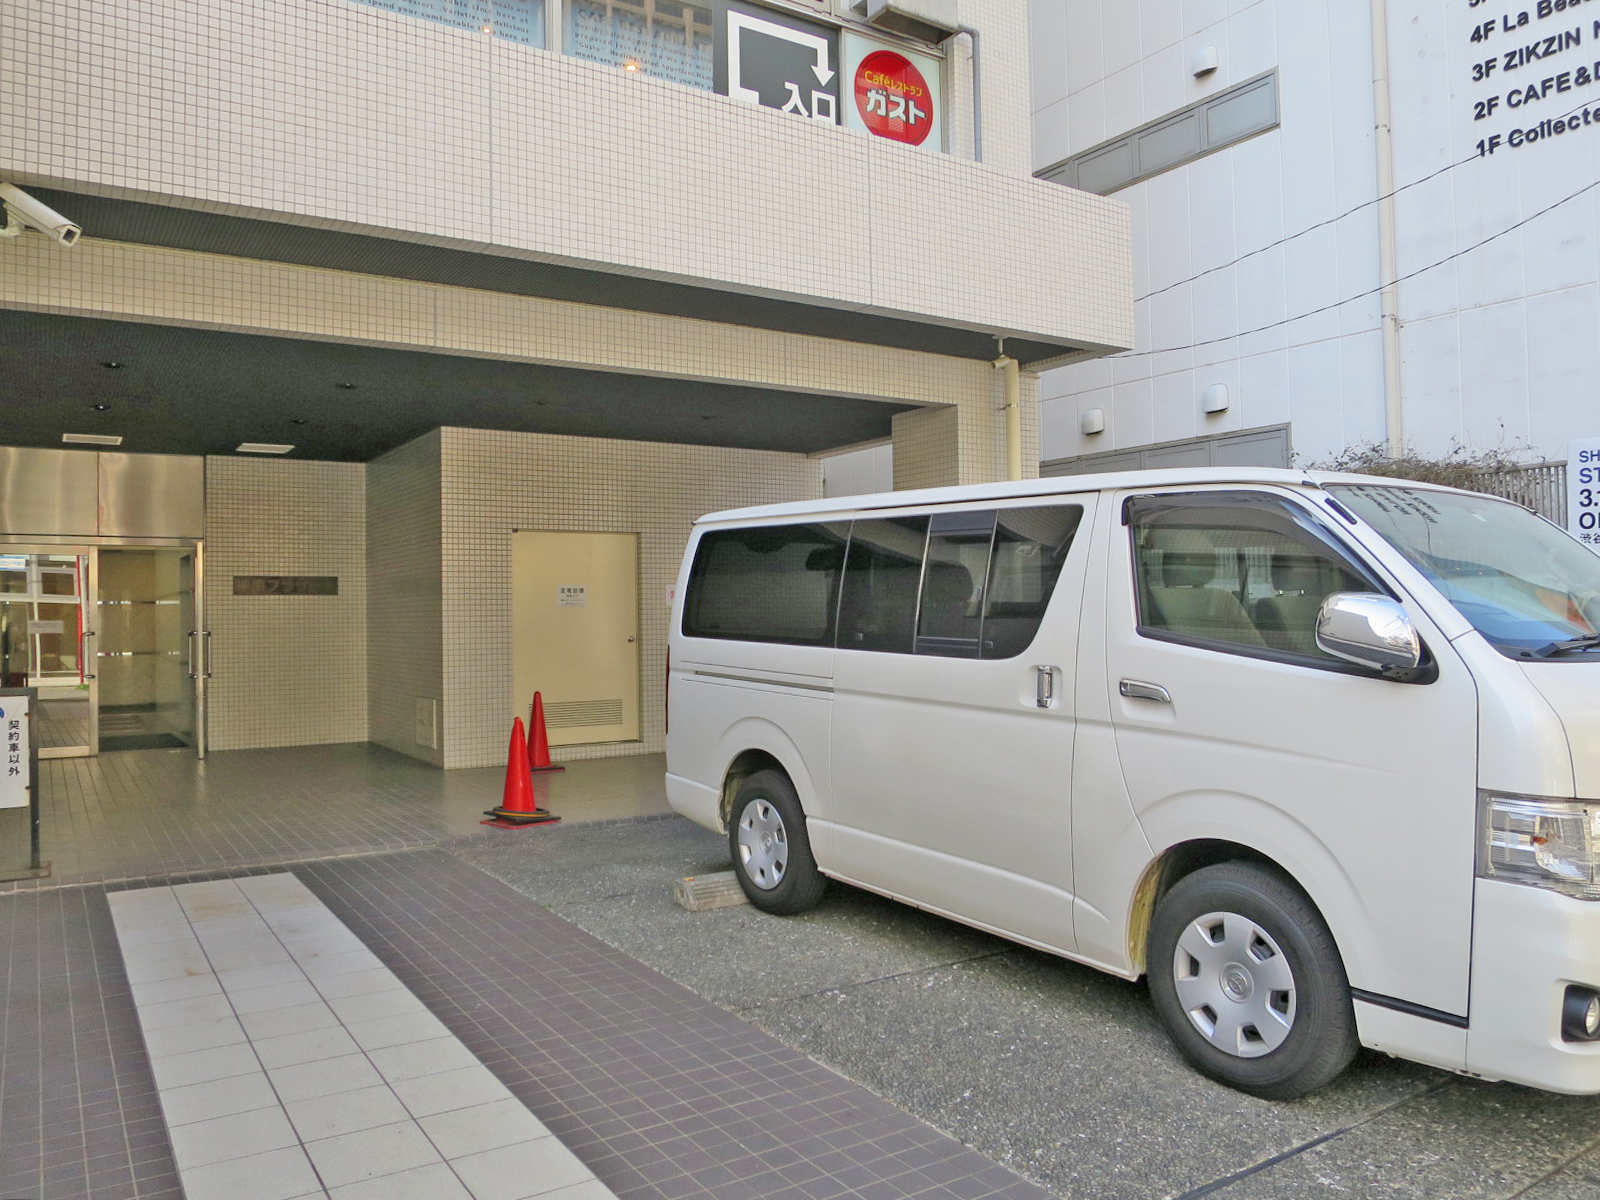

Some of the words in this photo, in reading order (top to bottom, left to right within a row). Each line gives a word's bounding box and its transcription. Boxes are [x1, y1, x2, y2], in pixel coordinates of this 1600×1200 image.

[1470, 19, 1496, 44] 4F
[1503, 11, 1530, 32] La
[1472, 57, 1497, 81] 3F
[1503, 27, 1581, 72] ZIKZIN
[781, 81, 836, 125] 入口
[866, 88, 927, 125] ガスト
[1474, 95, 1500, 121] 2F
[1475, 134, 1501, 157] 1F
[1578, 512, 1600, 530] O
[8, 720, 20, 776] 契約車以外
